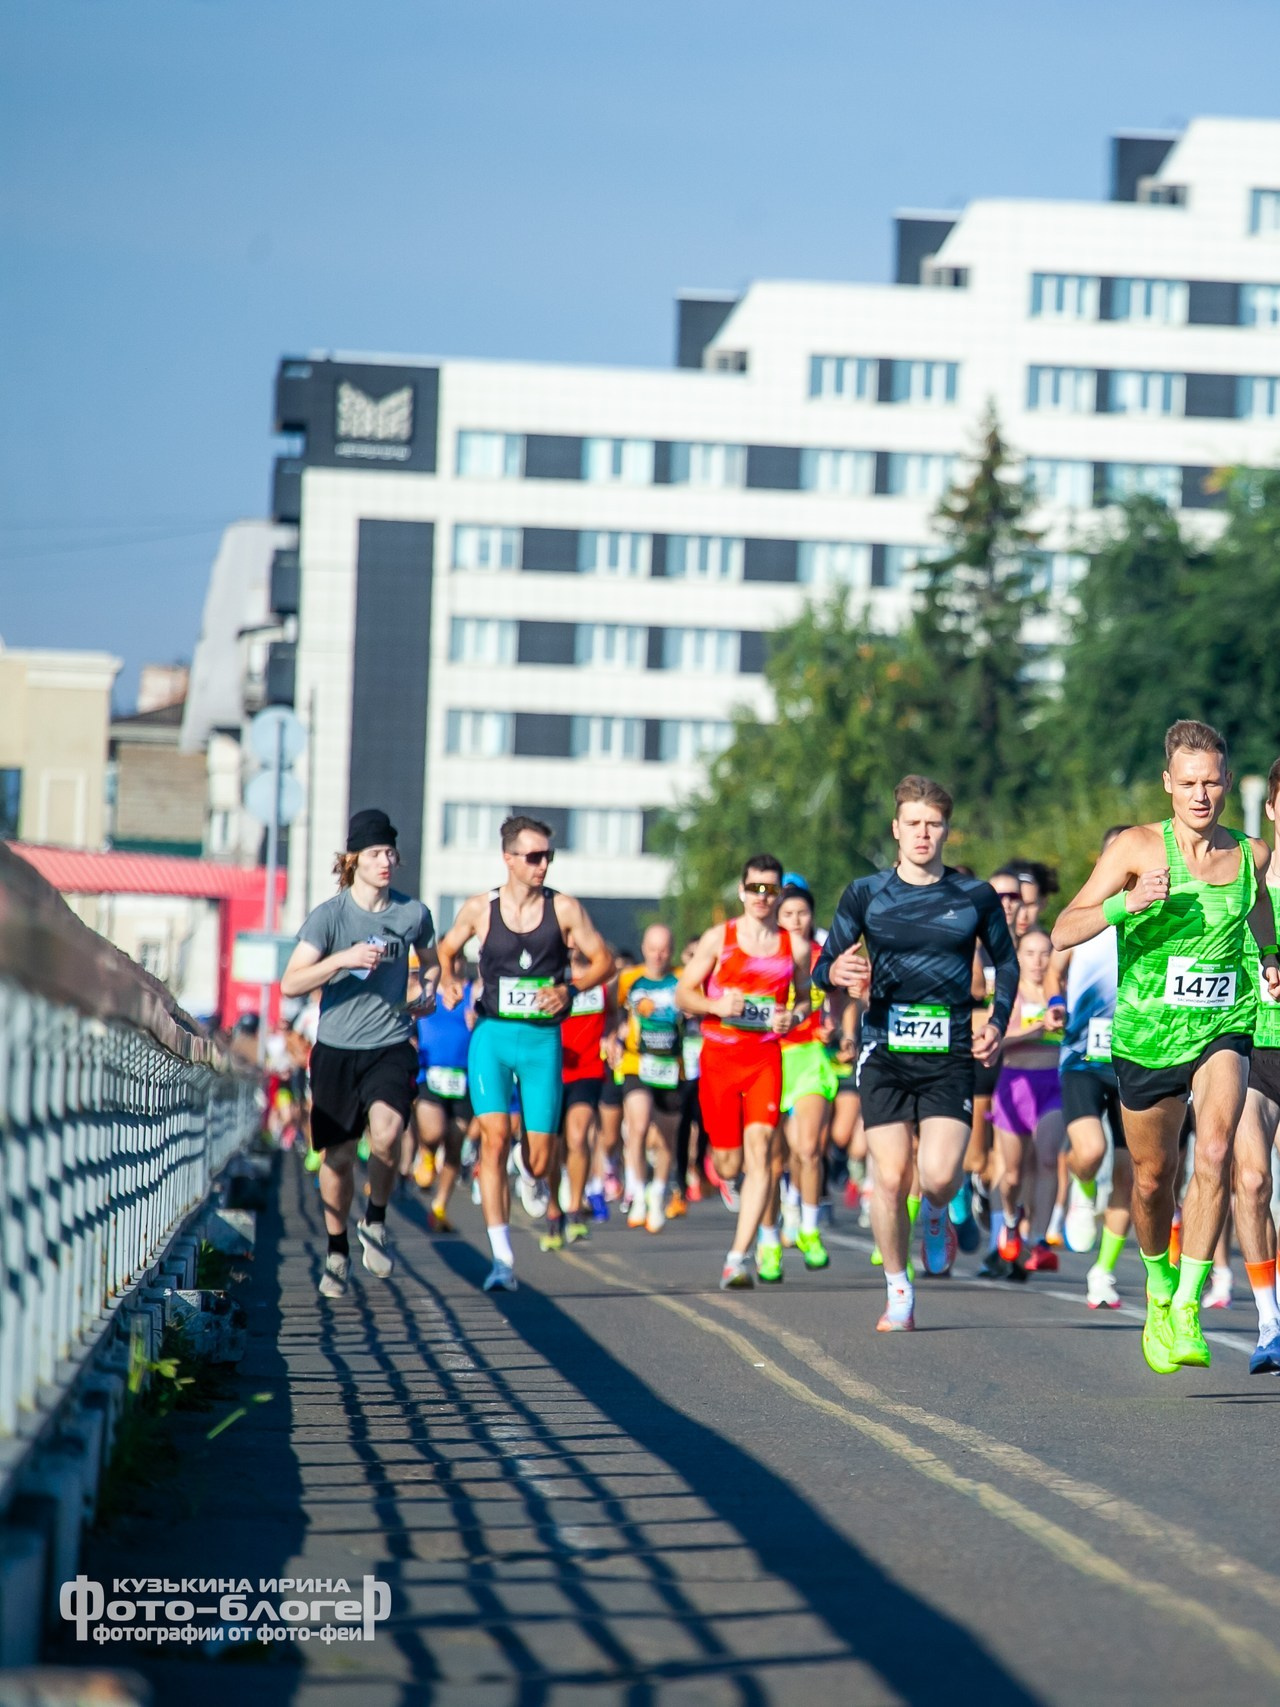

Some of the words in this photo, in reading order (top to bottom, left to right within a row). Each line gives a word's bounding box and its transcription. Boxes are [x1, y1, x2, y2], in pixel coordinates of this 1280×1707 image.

[1173, 975, 1230, 998] 1472
[507, 991, 536, 1006] 127
[747, 1006, 770, 1021] 98
[894, 1020, 943, 1038] 1474
[1093, 1033, 1112, 1049] 13
